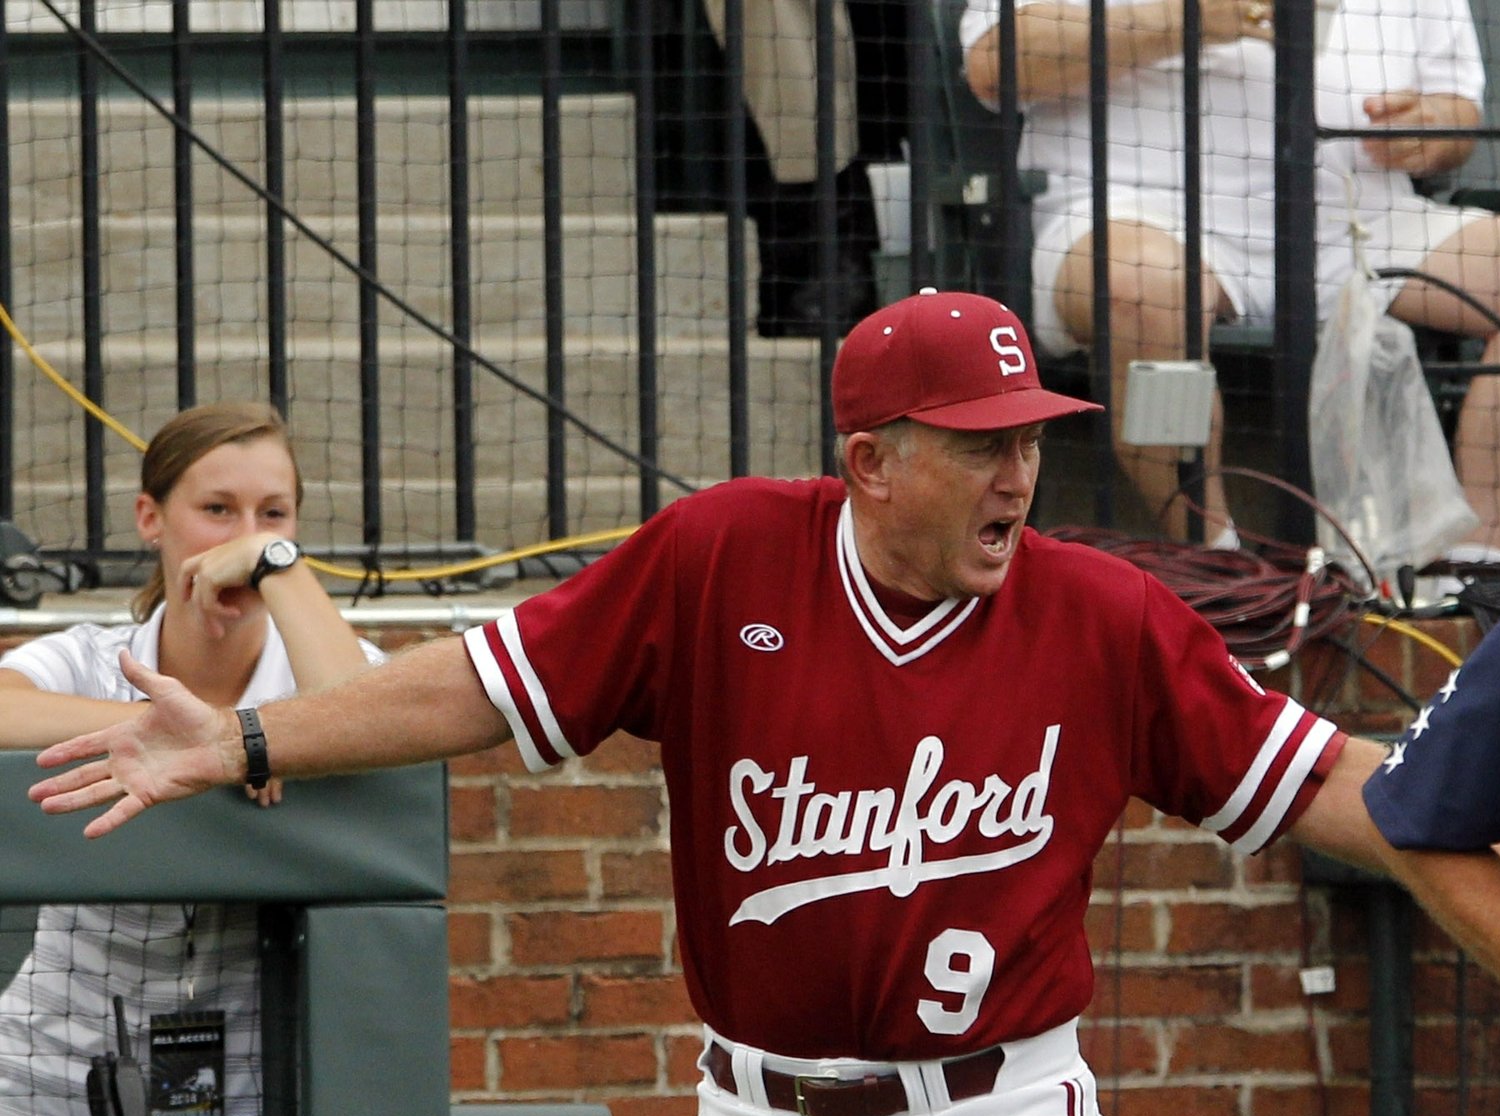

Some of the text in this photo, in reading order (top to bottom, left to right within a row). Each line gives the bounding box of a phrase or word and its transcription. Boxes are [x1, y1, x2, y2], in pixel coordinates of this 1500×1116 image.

[989, 325, 1027, 377] S
[724, 724, 1061, 898] Stanford
[917, 928, 996, 1035] 9
